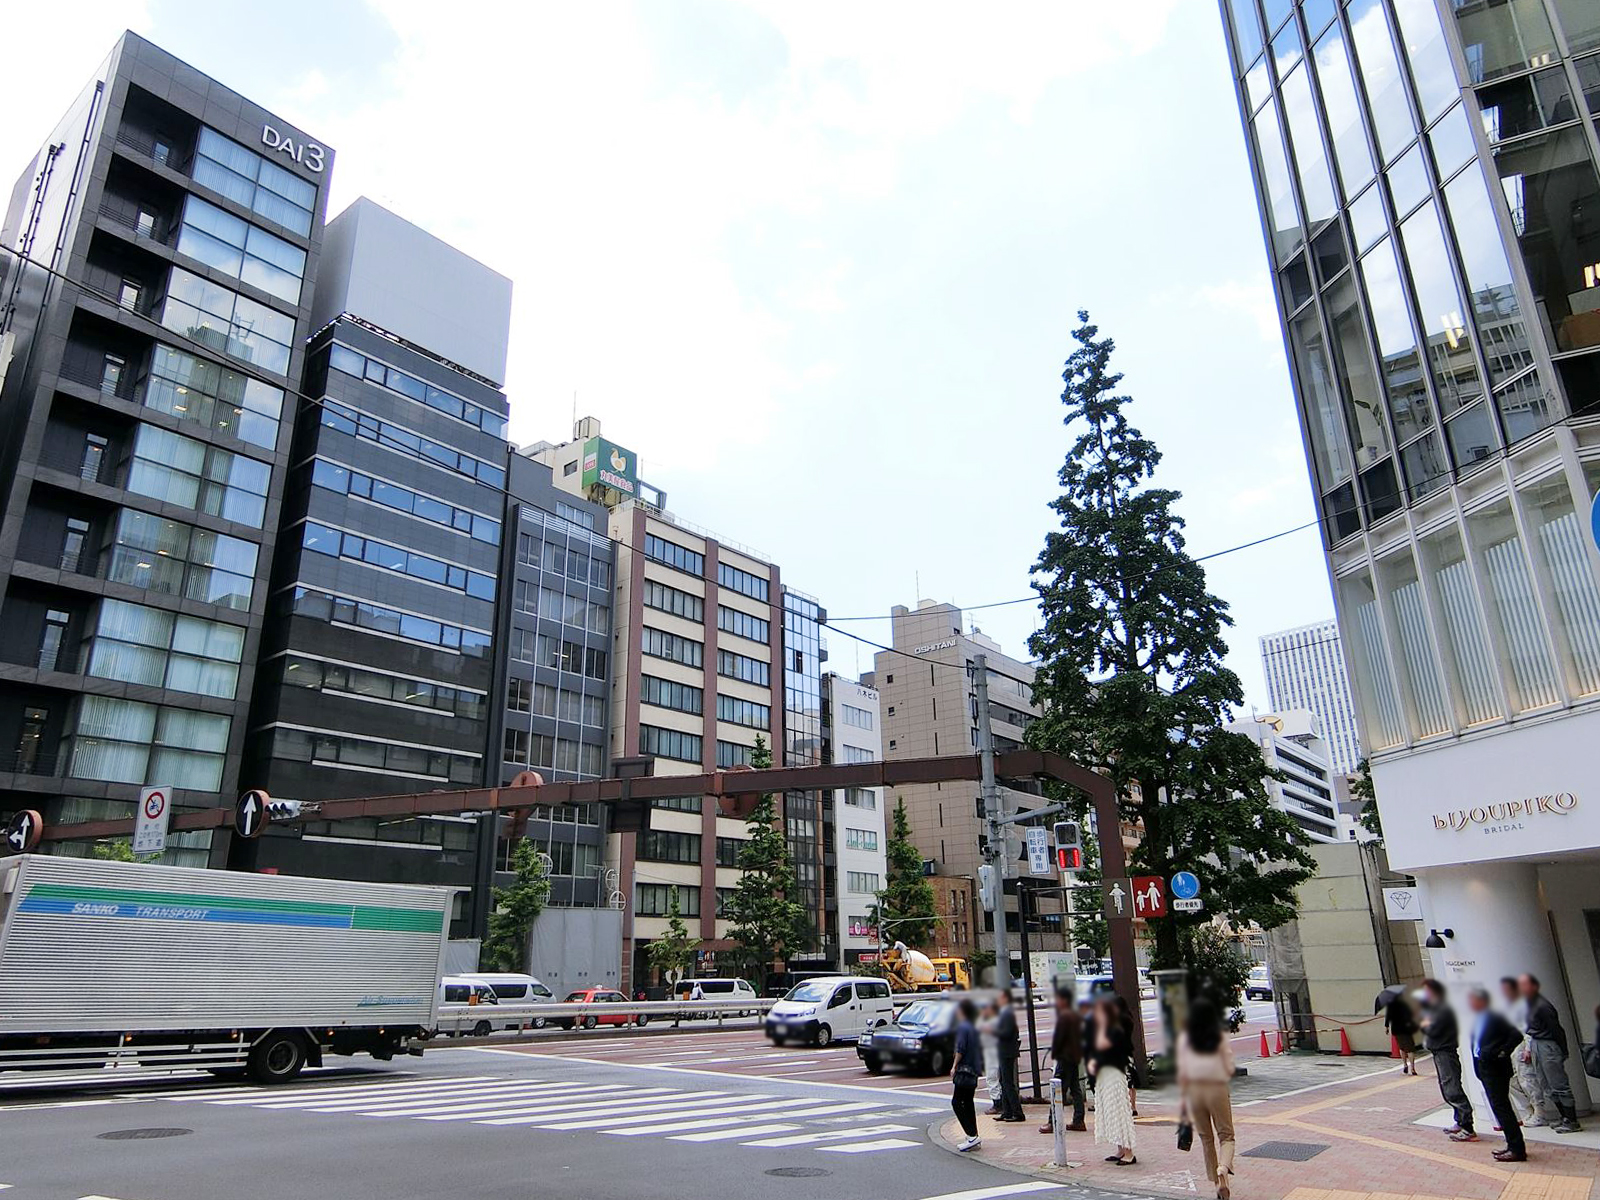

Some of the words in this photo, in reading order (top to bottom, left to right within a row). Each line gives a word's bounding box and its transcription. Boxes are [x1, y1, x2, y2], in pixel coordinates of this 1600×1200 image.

[262, 124, 325, 172] DAI3
[914, 639, 957, 655] OSHITANI
[857, 688, 878, 701] 八木ビル
[1483, 823, 1525, 835] BRIDAL
[71, 903, 120, 916] SANKO
[135, 906, 209, 920] TRANSPORT
